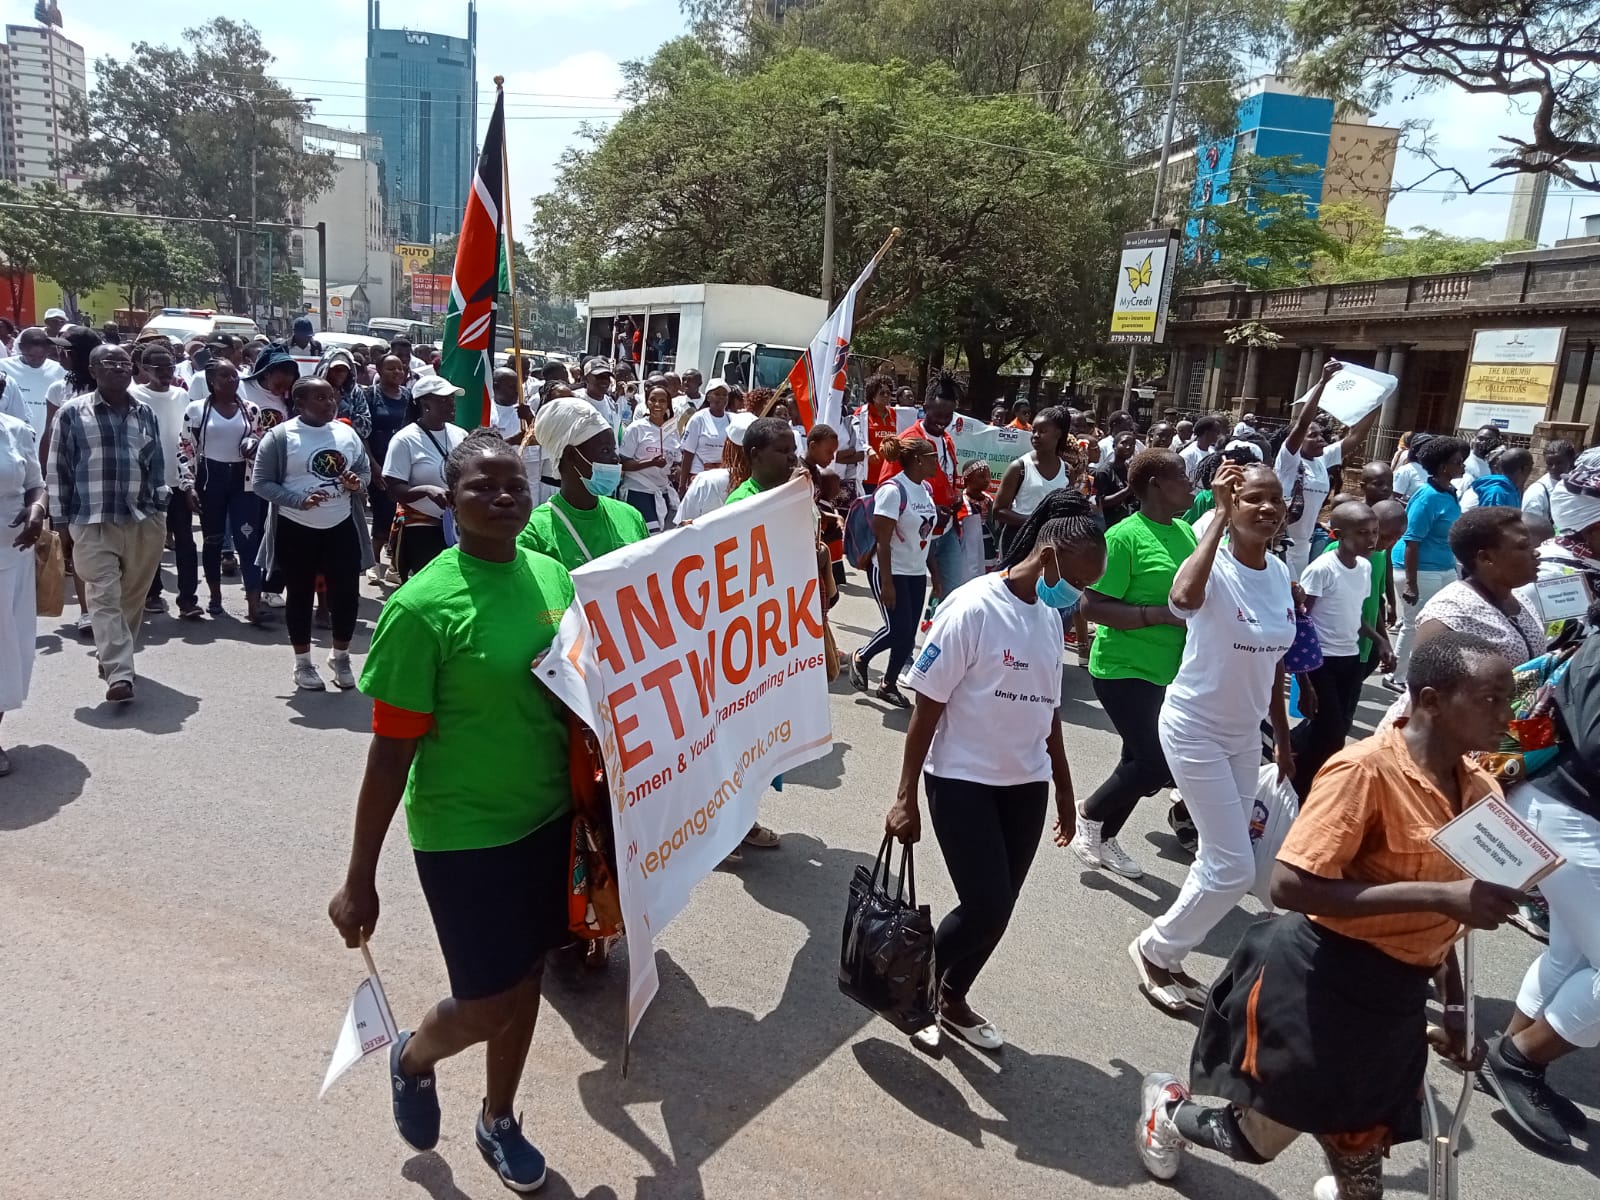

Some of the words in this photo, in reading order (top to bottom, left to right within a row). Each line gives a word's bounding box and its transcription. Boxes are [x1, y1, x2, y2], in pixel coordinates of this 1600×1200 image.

[401, 247, 430, 257] RUTO
[1120, 296, 1153, 309] MyCredit
[1233, 642, 1257, 653] Unity
[994, 689, 1018, 702] Unity
[1020, 693, 1028, 702] In
[677, 754, 687, 774] &
[787, 653, 825, 678] Lives
[1486, 801, 1519, 834] #ELECTIONS
[1517, 828, 1532, 845] BILA
[1530, 841, 1552, 861] NOMA
[1473, 834, 1492, 854] Peace
[1490, 849, 1507, 867] Walk
[1475, 822, 1499, 844] National
[1496, 837, 1524, 867] Women's
